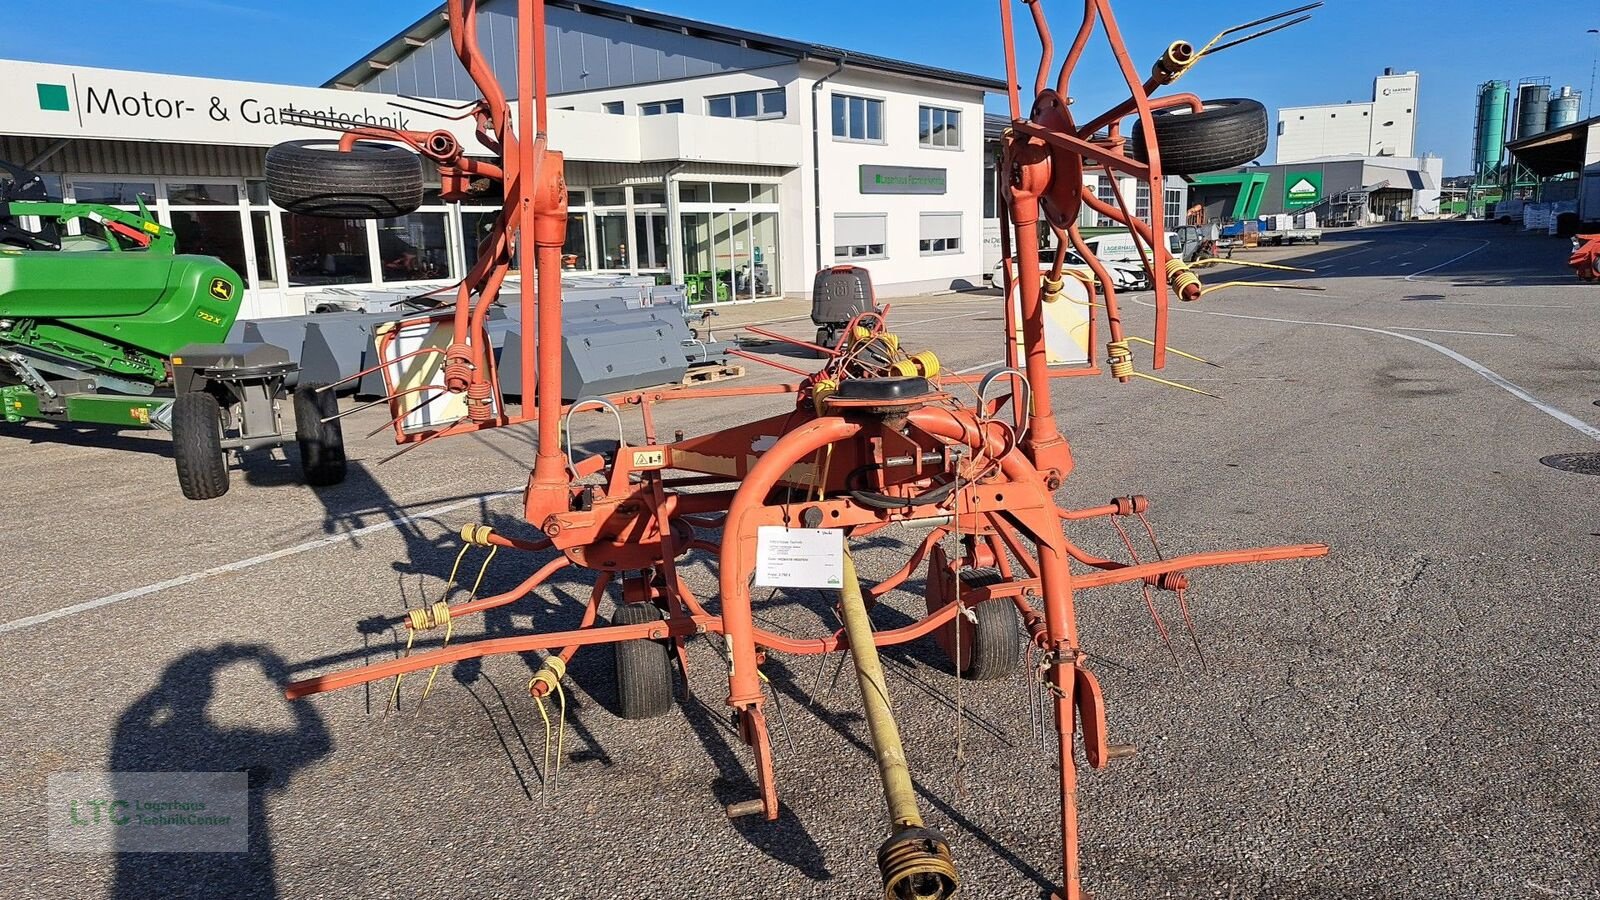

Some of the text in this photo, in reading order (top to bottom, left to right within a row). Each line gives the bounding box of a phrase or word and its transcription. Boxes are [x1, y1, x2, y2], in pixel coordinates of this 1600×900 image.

[87, 87, 194, 119] Motor-
[208, 96, 230, 123] &
[197, 311, 214, 322] 722
